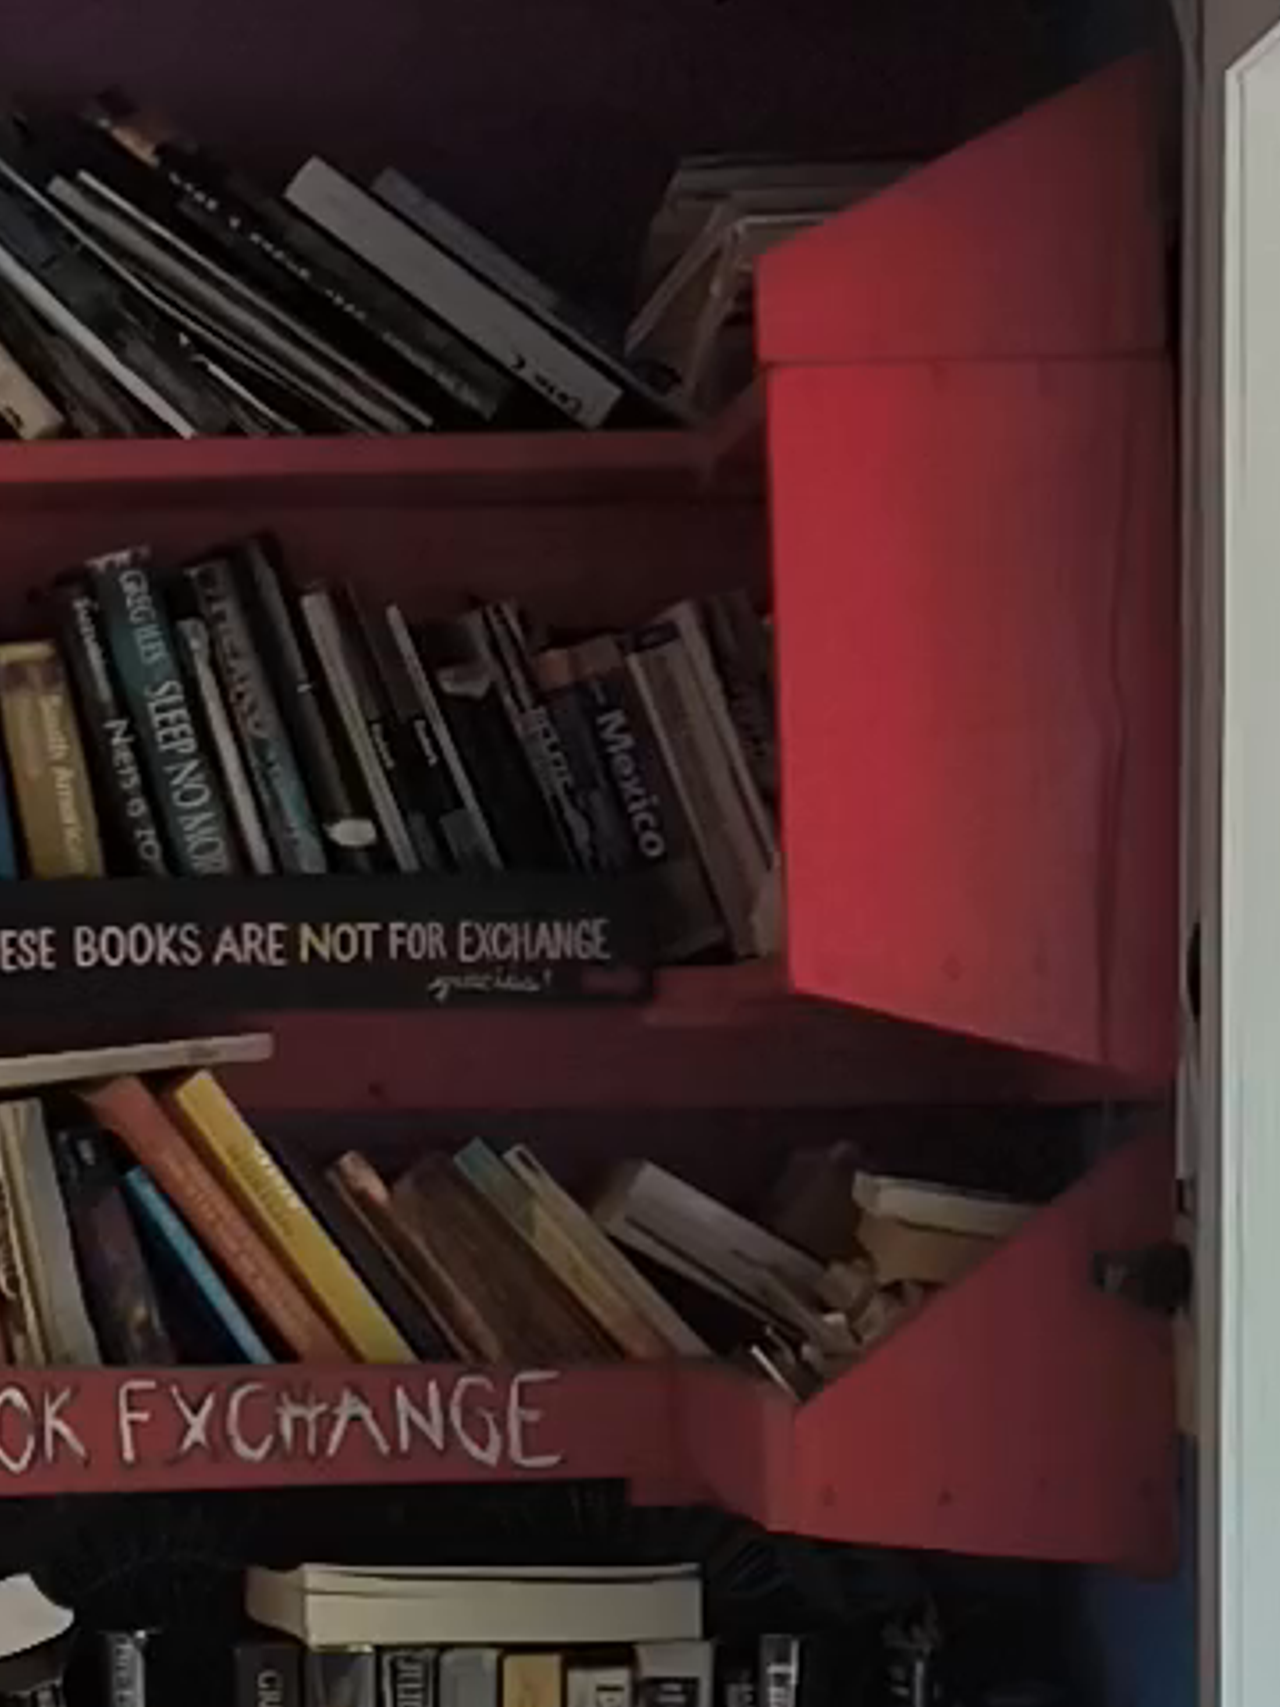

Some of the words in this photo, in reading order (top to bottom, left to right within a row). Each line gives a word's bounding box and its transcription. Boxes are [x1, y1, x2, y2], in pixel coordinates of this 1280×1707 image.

[146, 679, 197, 756] SLEEP
[165, 758, 211, 807] NO
[596, 709, 665, 858] Mexico
[73, 923, 199, 969] BOOKS
[212, 922, 287, 967] ARE
[298, 921, 381, 964] NOT
[388, 921, 448, 960] FOR
[459, 918, 611, 963] EXCHANGE
